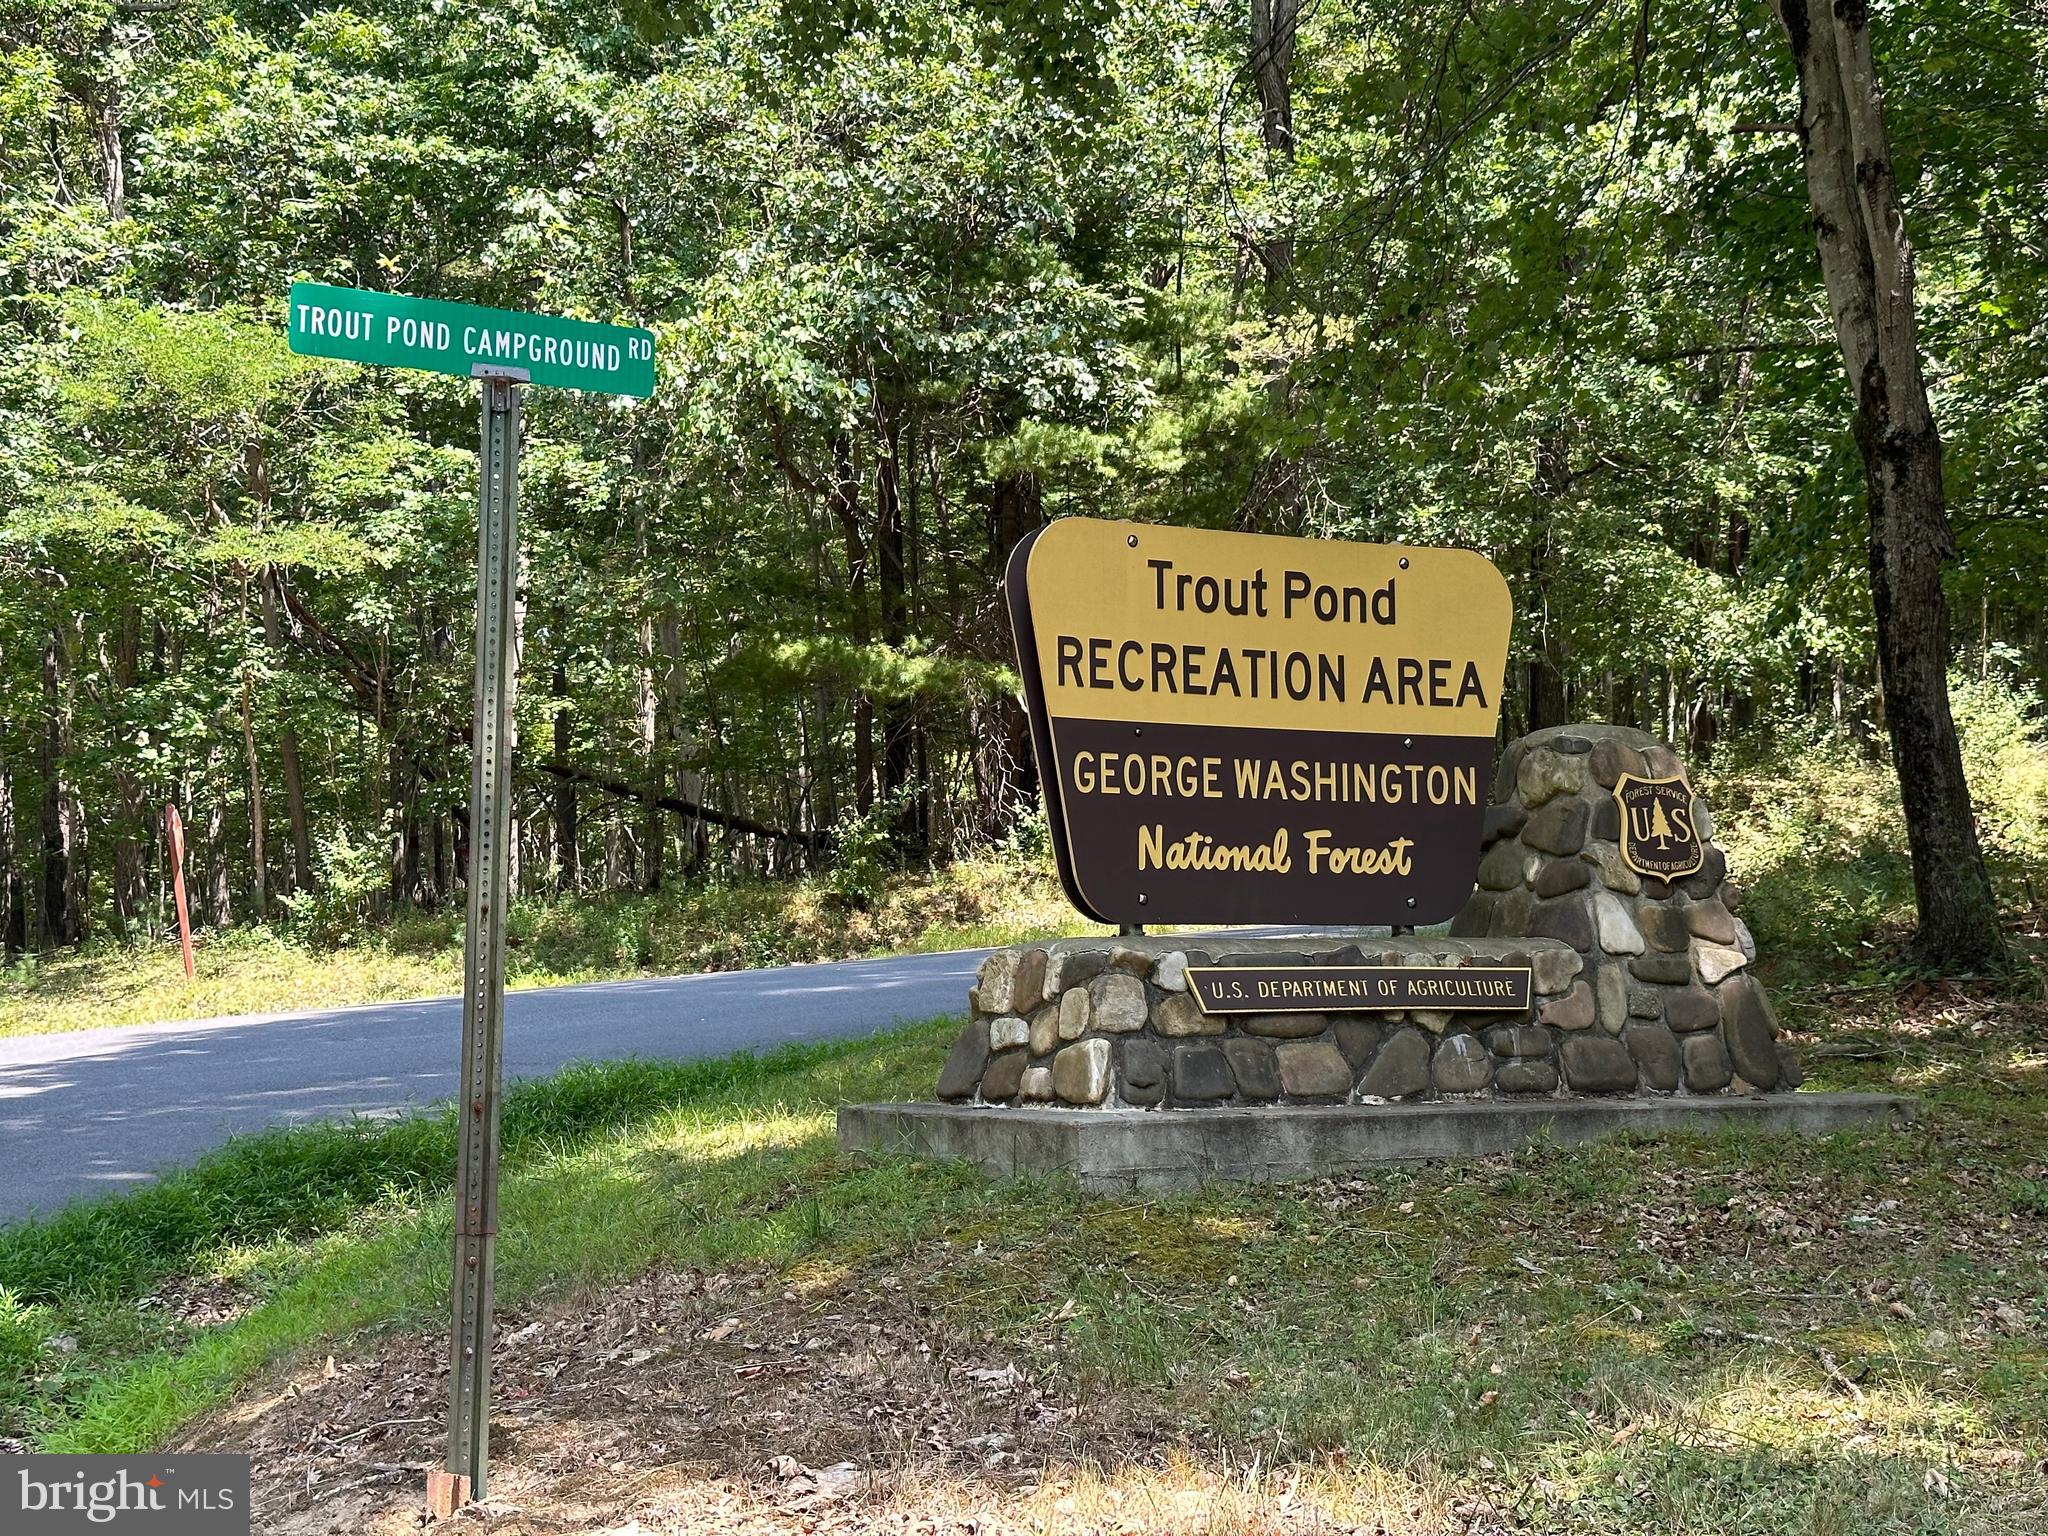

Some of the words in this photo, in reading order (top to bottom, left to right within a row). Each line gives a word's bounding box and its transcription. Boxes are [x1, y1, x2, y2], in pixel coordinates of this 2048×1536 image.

[297, 304, 374, 341] TROUT
[386, 316, 451, 350] POND
[463, 326, 620, 372] CAMPGROUND
[628, 336, 652, 361] RD
[1147, 559, 1268, 618] Trout
[1283, 571, 1396, 625] Pond
[1057, 635, 1346, 703] RECREATION
[1362, 656, 1488, 708] AREA
[1073, 751, 1223, 798] GEORGE
[1234, 758, 1477, 805] WASHINGTON
[1625, 786, 1653, 804] FOREST
[1656, 785, 1687, 804] SERVICE
[1138, 824, 1292, 875] National
[1303, 829, 1414, 876] Forest
[1628, 842, 1662, 870] DEPARTMENT
[1663, 862, 1670, 870] OF
[1671, 842, 1699, 871] AGRICULTURE
[1212, 981, 1249, 999] U.S.
[1259, 980, 1368, 998] DEPARTMENT
[1378, 980, 1398, 996] OF
[1408, 980, 1516, 997] AGRICULTURE
